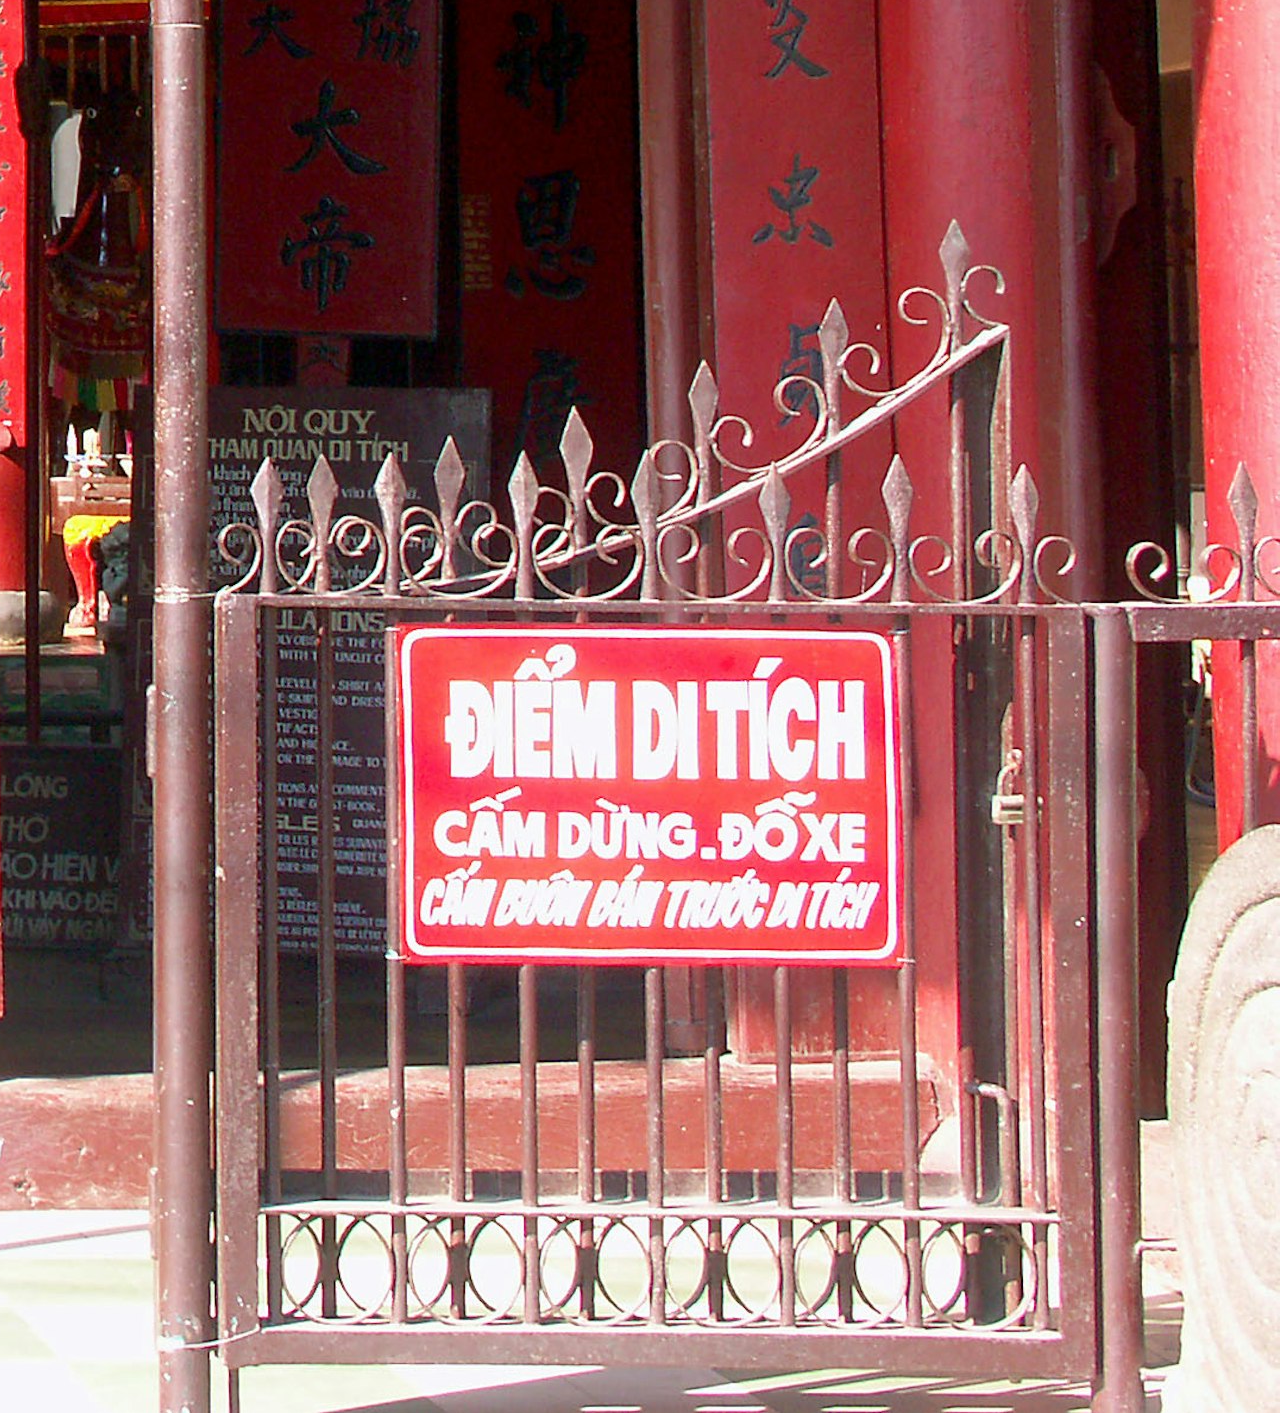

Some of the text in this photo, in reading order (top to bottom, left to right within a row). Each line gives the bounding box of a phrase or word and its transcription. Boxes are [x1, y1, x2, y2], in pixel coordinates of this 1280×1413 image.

[242, 404, 376, 437] NỘI QUY
[263, 439, 323, 462] QUAN
[329, 440, 351, 462] DI
[357, 432, 408, 463] TÍCH
[445, 644, 866, 781] ĐIỂM DI TÍCH
[433, 786, 547, 858] CẤM
[800, 812, 866, 863] XE
[420, 861, 499, 927] CẤM
[496, 869, 594, 928] BUÔN
[588, 864, 664, 928] BÁN
[664, 869, 769, 928] TRƯỚC
[765, 881, 809, 928] DI
[804, 867, 881, 929] TÍCH
